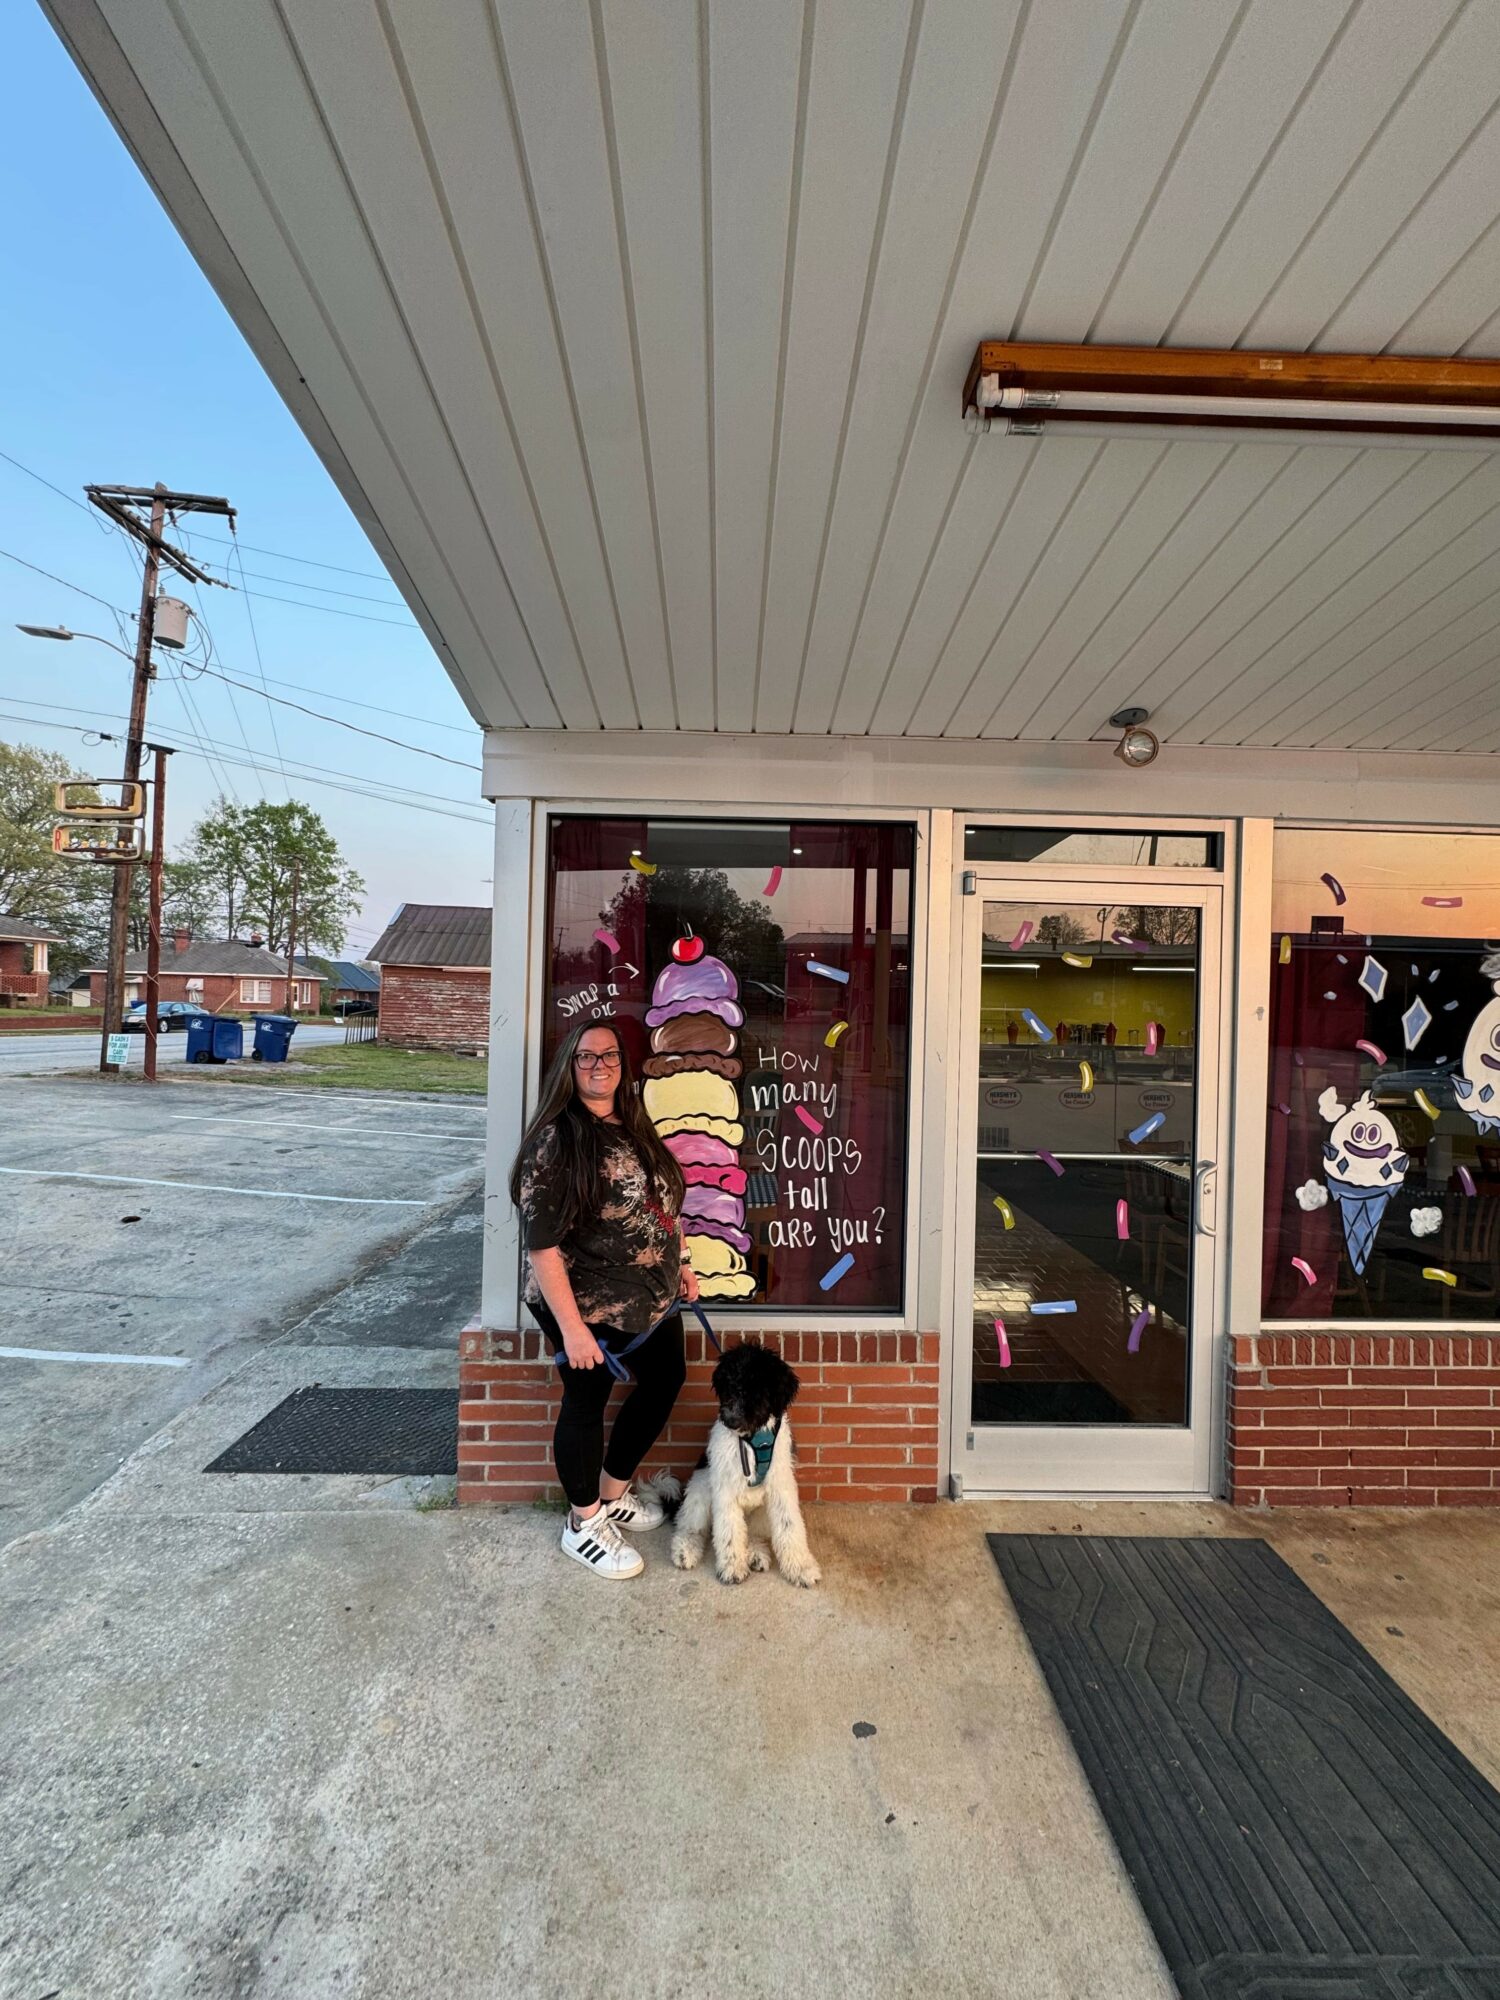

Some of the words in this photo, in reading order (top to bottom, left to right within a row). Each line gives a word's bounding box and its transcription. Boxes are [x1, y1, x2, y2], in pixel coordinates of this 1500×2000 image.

[607, 983, 620, 996] a
[751, 1080, 837, 1118] many
[756, 1129, 862, 1174] SCOOPS
[783, 1177, 828, 1211] tall
[827, 1206, 886, 1253] you?
